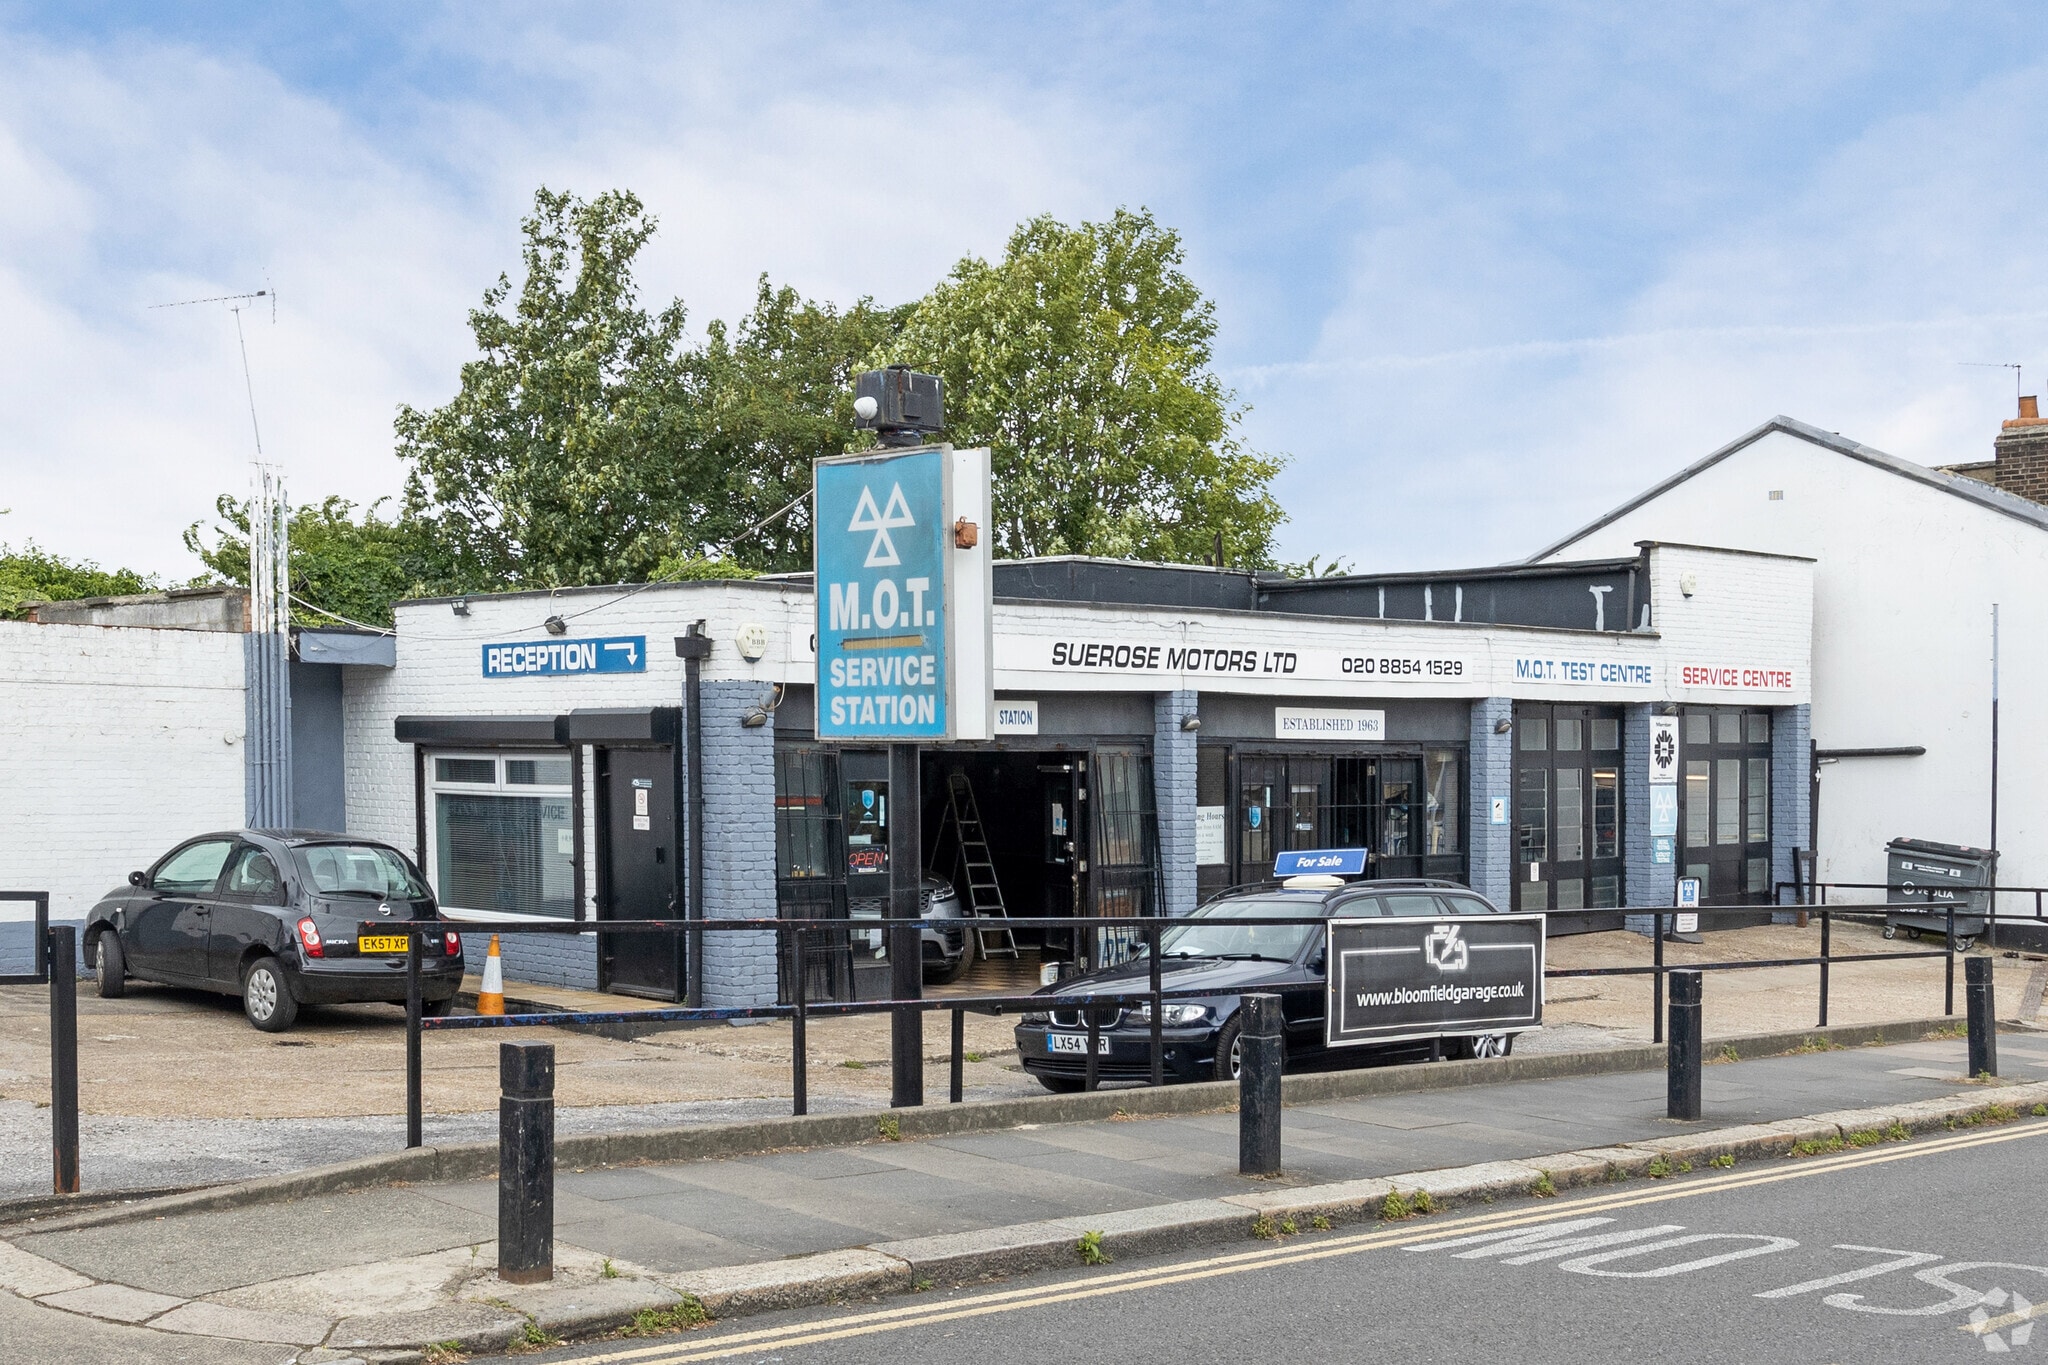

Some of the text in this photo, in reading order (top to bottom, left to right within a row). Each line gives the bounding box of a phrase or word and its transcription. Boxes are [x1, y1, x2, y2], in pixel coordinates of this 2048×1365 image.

[829, 577, 935, 631] M.O.T.
[488, 643, 596, 673] RECEPTION
[1051, 642, 1298, 673] SUEROSE MOTORS LTD
[1342, 657, 1463, 676] 020 8854 1529
[830, 655, 936, 688] SERVICE
[1516, 659, 1652, 684] M.O.T. TEST CENTRE
[1682, 666, 1792, 688] SERVICE CENTRE
[830, 694, 935, 726] STATION
[999, 710, 1033, 726] STATION
[1282, 717, 1379, 732] ESTABLISHED 1963
[848, 852, 885, 866] OPEN
[1296, 855, 1343, 868] For Sale
[363, 938, 409, 950] EK57 XP
[1356, 981, 1525, 1007] www.bloomfieldgarage.co.uk
[1053, 1036, 1081, 1050] LX54
[1400, 1217, 2048, 1316] SLOW
